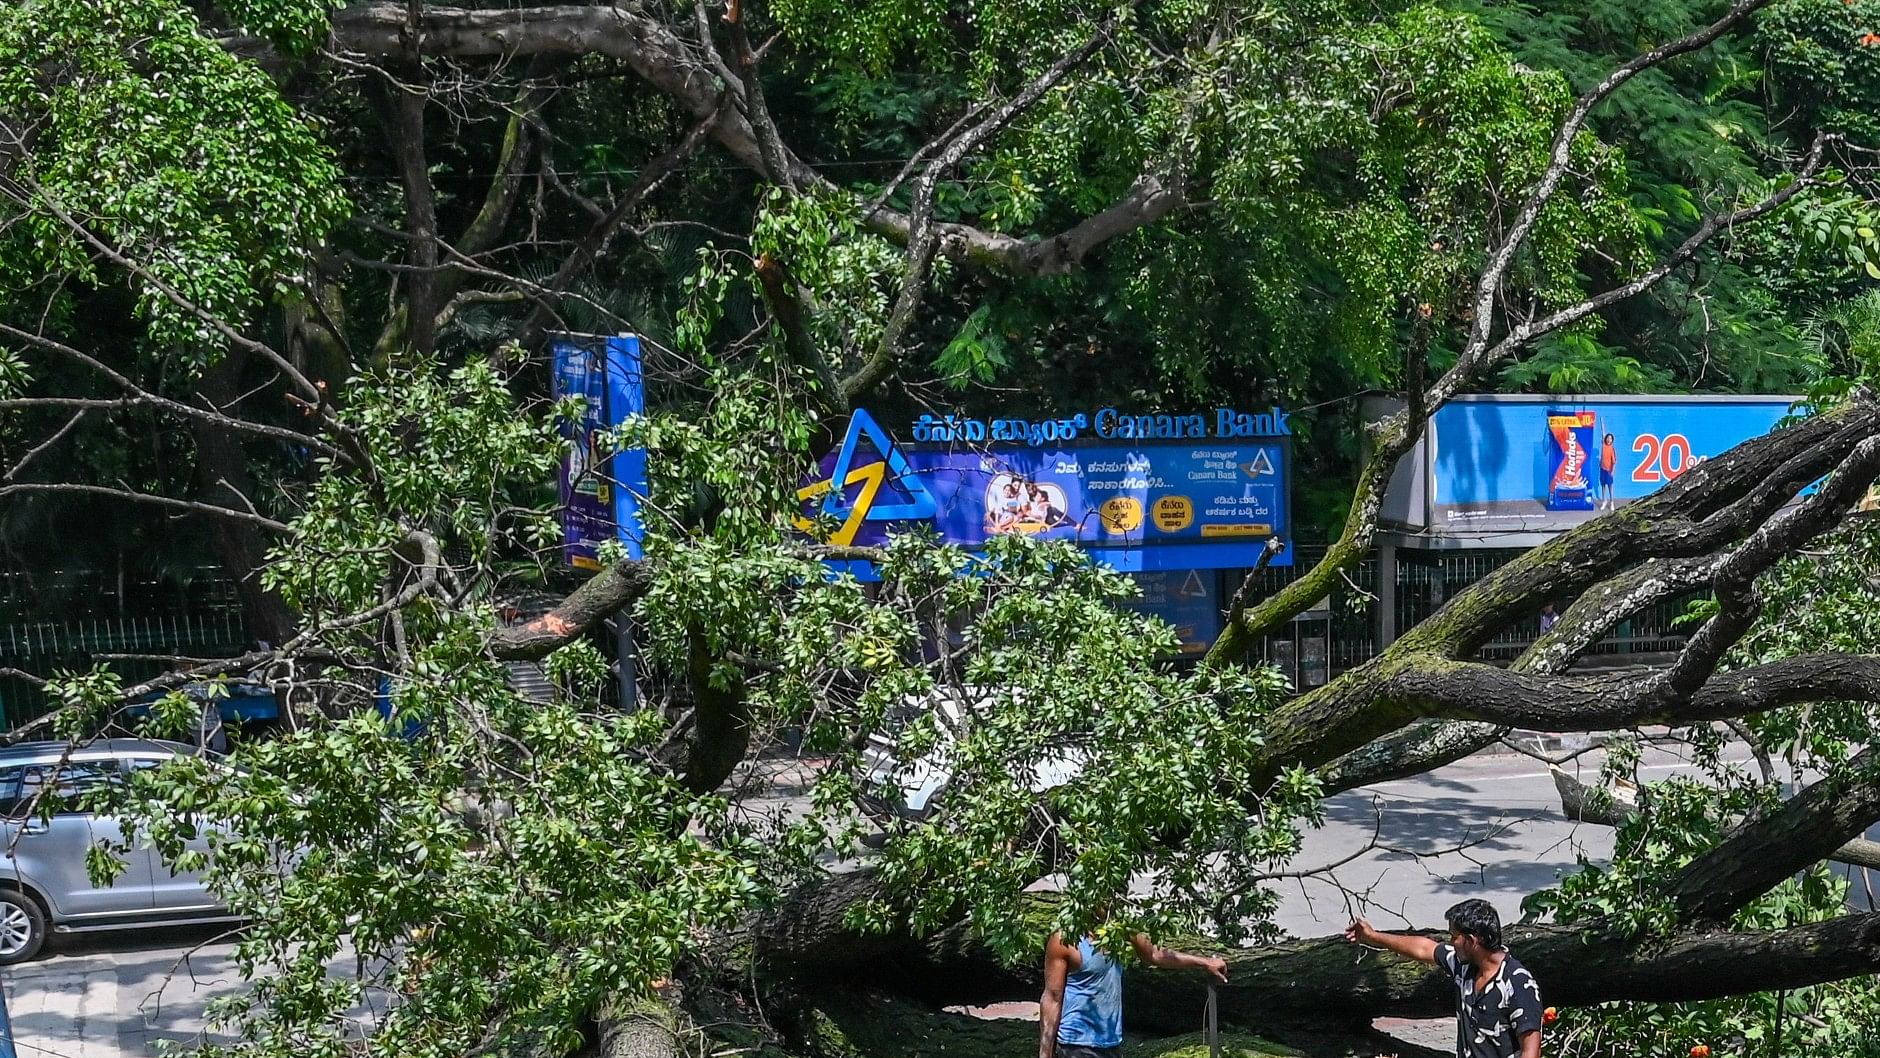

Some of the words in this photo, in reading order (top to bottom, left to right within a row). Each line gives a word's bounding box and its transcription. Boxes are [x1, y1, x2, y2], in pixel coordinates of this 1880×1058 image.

[991, 412, 1088, 447] ಬ್ಯಾಂಕ್
[1094, 407, 1206, 439] Canara
[1216, 406, 1291, 437] Bank
[1055, 461, 1085, 478] ನಿಮ್ಮ
[1564, 431, 1577, 476] Horlicks
[1217, 470, 1238, 480] Bank
